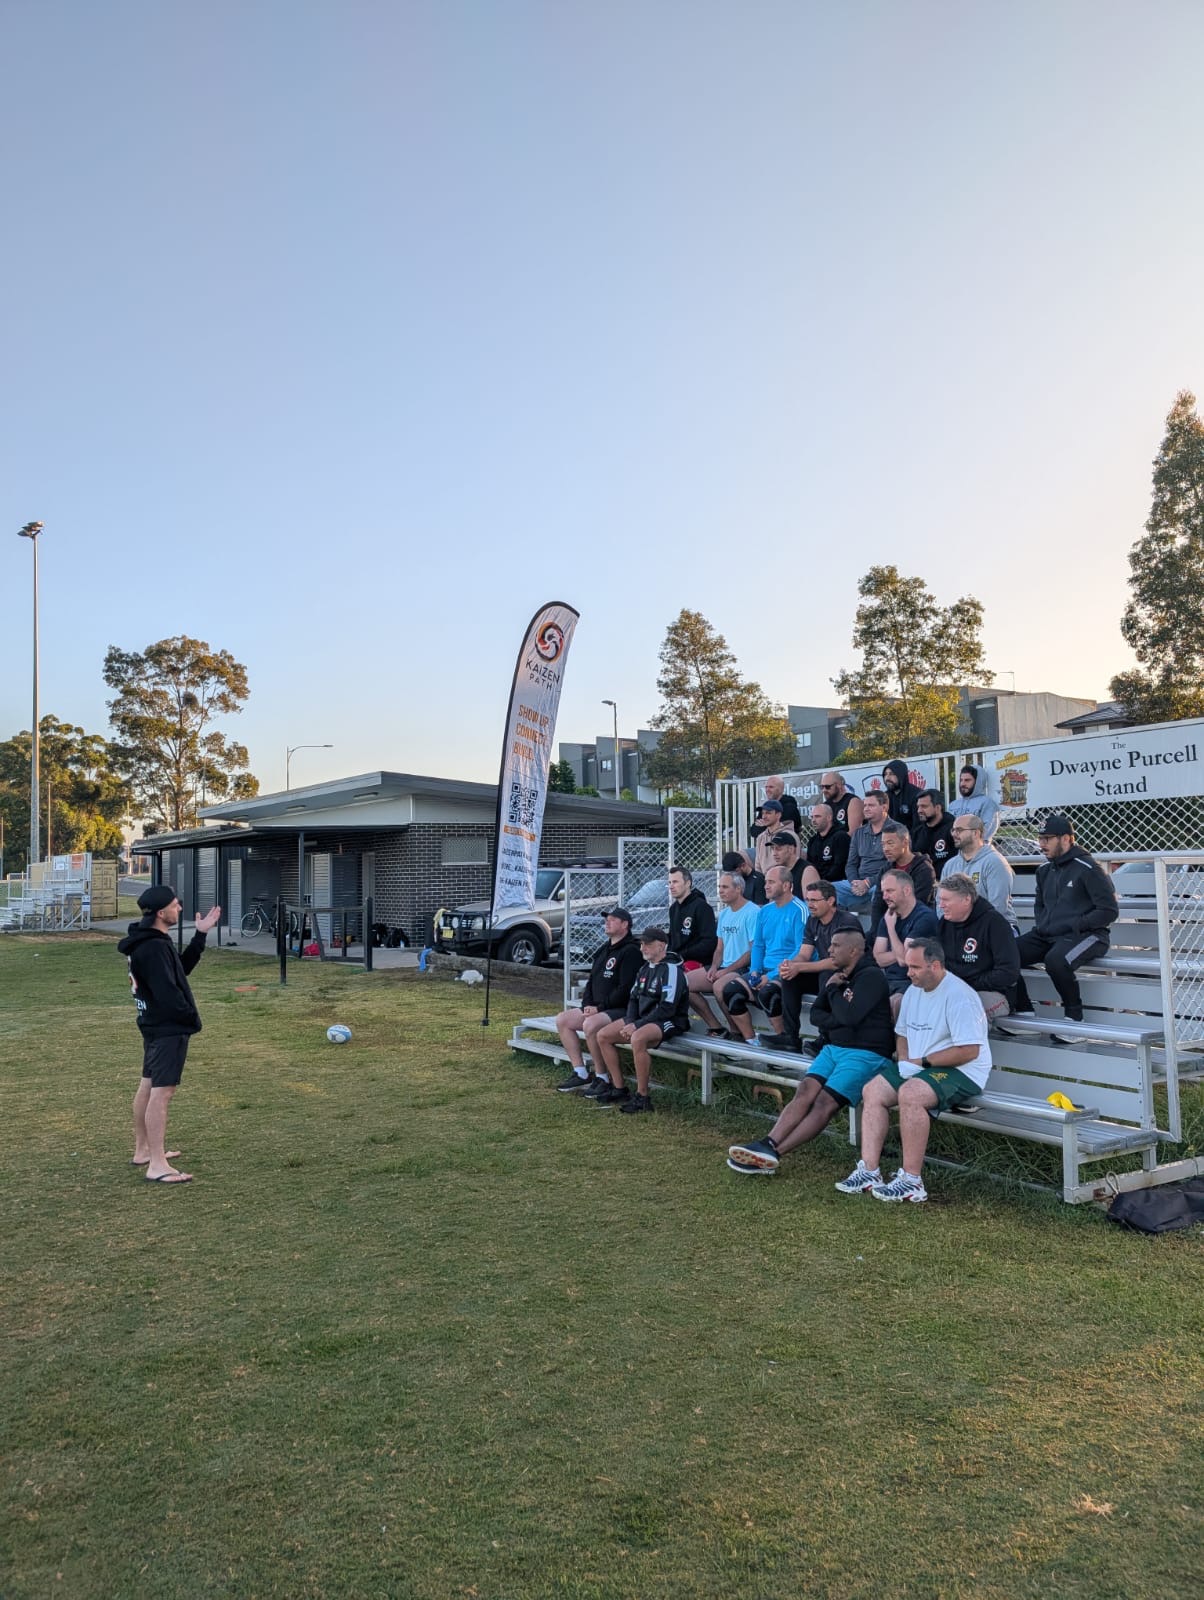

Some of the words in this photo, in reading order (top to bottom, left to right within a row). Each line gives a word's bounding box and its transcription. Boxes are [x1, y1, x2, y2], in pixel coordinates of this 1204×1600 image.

[525, 658, 561, 685] KAIZEN
[529, 673, 553, 691] PATH
[518, 704, 539, 723] SHOW
[1111, 742, 1126, 750] The
[1049, 757, 1122, 778] Dwayne
[1127, 744, 1199, 768] Purcell
[1095, 776, 1148, 796] Stand
